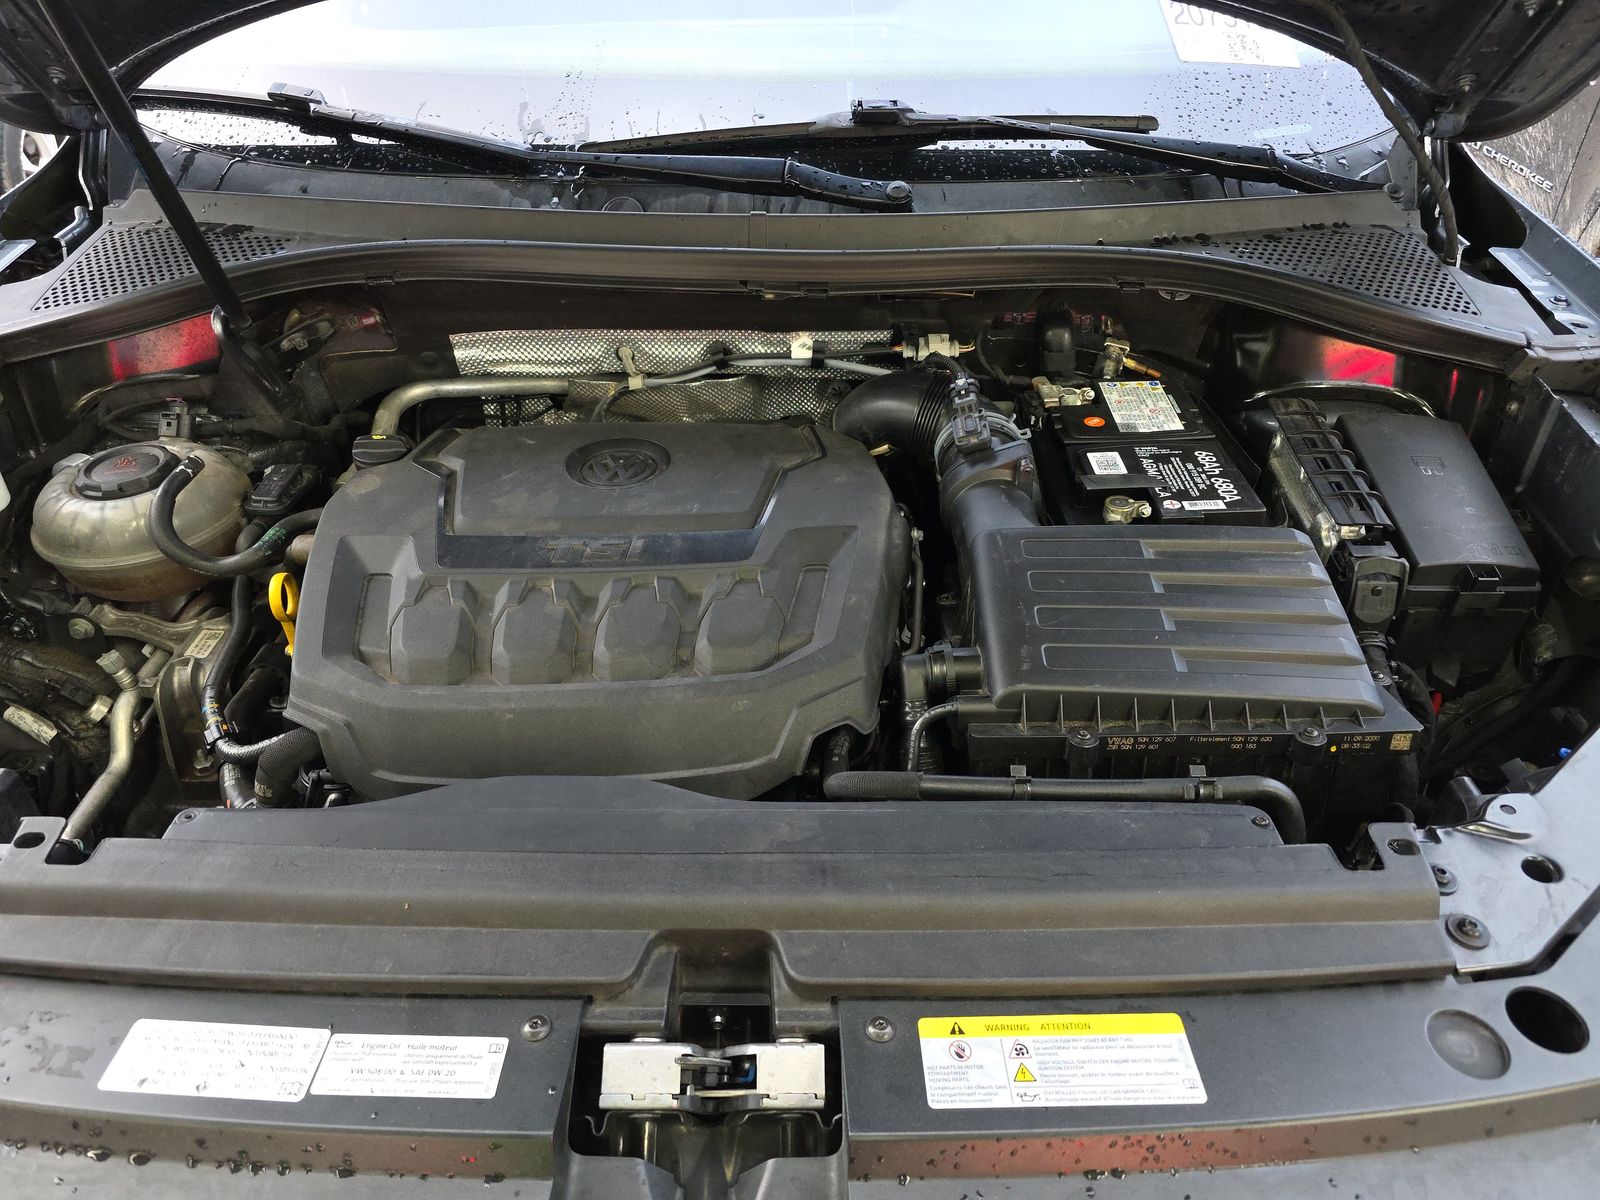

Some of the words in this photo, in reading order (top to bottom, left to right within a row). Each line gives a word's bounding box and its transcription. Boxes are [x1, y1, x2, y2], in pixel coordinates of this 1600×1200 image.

[1483, 145, 1553, 193] CHEROKEE
[1194, 451, 1223, 475] 68Ah
[1211, 477, 1242, 503] 680A
[544, 539, 646, 563] TSI
[1107, 736, 1134, 745] VWAG
[985, 1023, 1029, 1031] WARNING
[1040, 1022, 1090, 1031] ATTENTION
[362, 1043, 387, 1051] Engine
[390, 1042, 402, 1050] Oil
